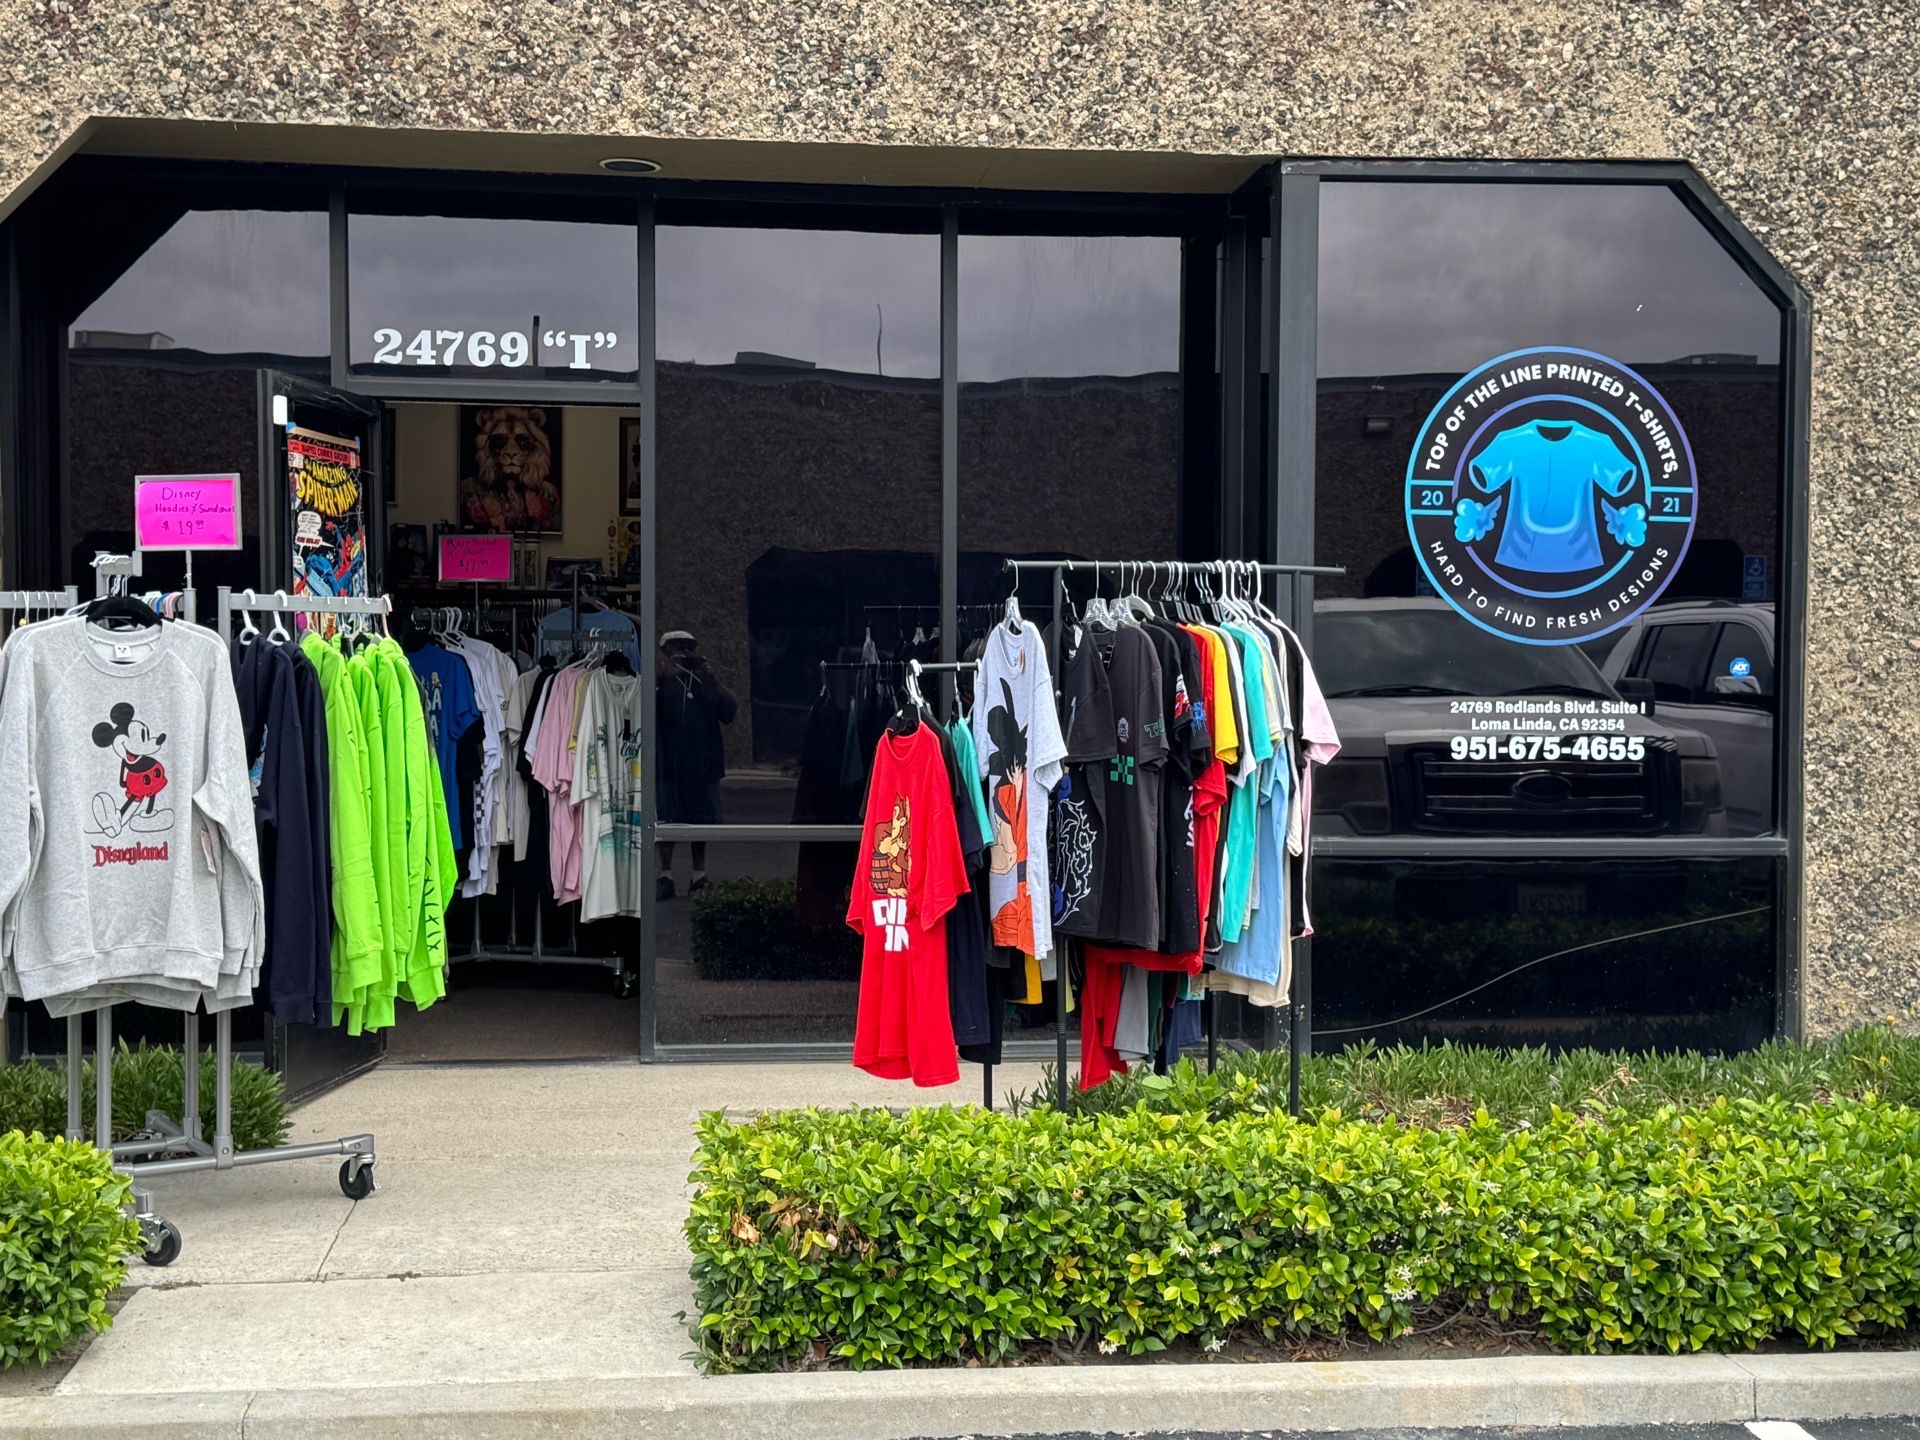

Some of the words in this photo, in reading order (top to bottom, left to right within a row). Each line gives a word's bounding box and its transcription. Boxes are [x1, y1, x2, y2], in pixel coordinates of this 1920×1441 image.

[373, 328, 529, 367] 24769
[1425, 432, 1450, 472] TOP
[1445, 405, 1467, 432] OF
[1464, 378, 1501, 409] THE
[1500, 364, 1542, 389] LINE
[1546, 363, 1625, 398] PRINTED
[1625, 392, 1679, 479] T-SHIRTS,
[312, 461, 347, 483] AMAZING
[161, 487, 201, 501] Disney
[296, 471, 358, 517] SPIDER-MAN
[1421, 490, 1444, 506] 20
[1662, 497, 1680, 513] 21
[155, 503, 189, 513] Hoodies
[1430, 541, 1463, 587] HARD
[1467, 588, 1488, 609] TO
[1494, 606, 1536, 628] FIND
[1546, 609, 1602, 629] FRESH
[1608, 547, 1669, 612] DESIGNS
[1450, 701, 1492, 714] 24769
[1495, 700, 1562, 714] Redlands
[1564, 700, 1599, 714] Blvd.
[1601, 701, 1639, 714] Suite
[1640, 701, 1646, 714] I
[1471, 718, 1511, 731] Loma
[1513, 718, 1556, 732] Linda,
[1559, 718, 1579, 731] CA
[1581, 718, 1625, 731] 92354
[1450, 736, 1646, 761] 951-675-4655
[91, 841, 169, 867] Disneyland
